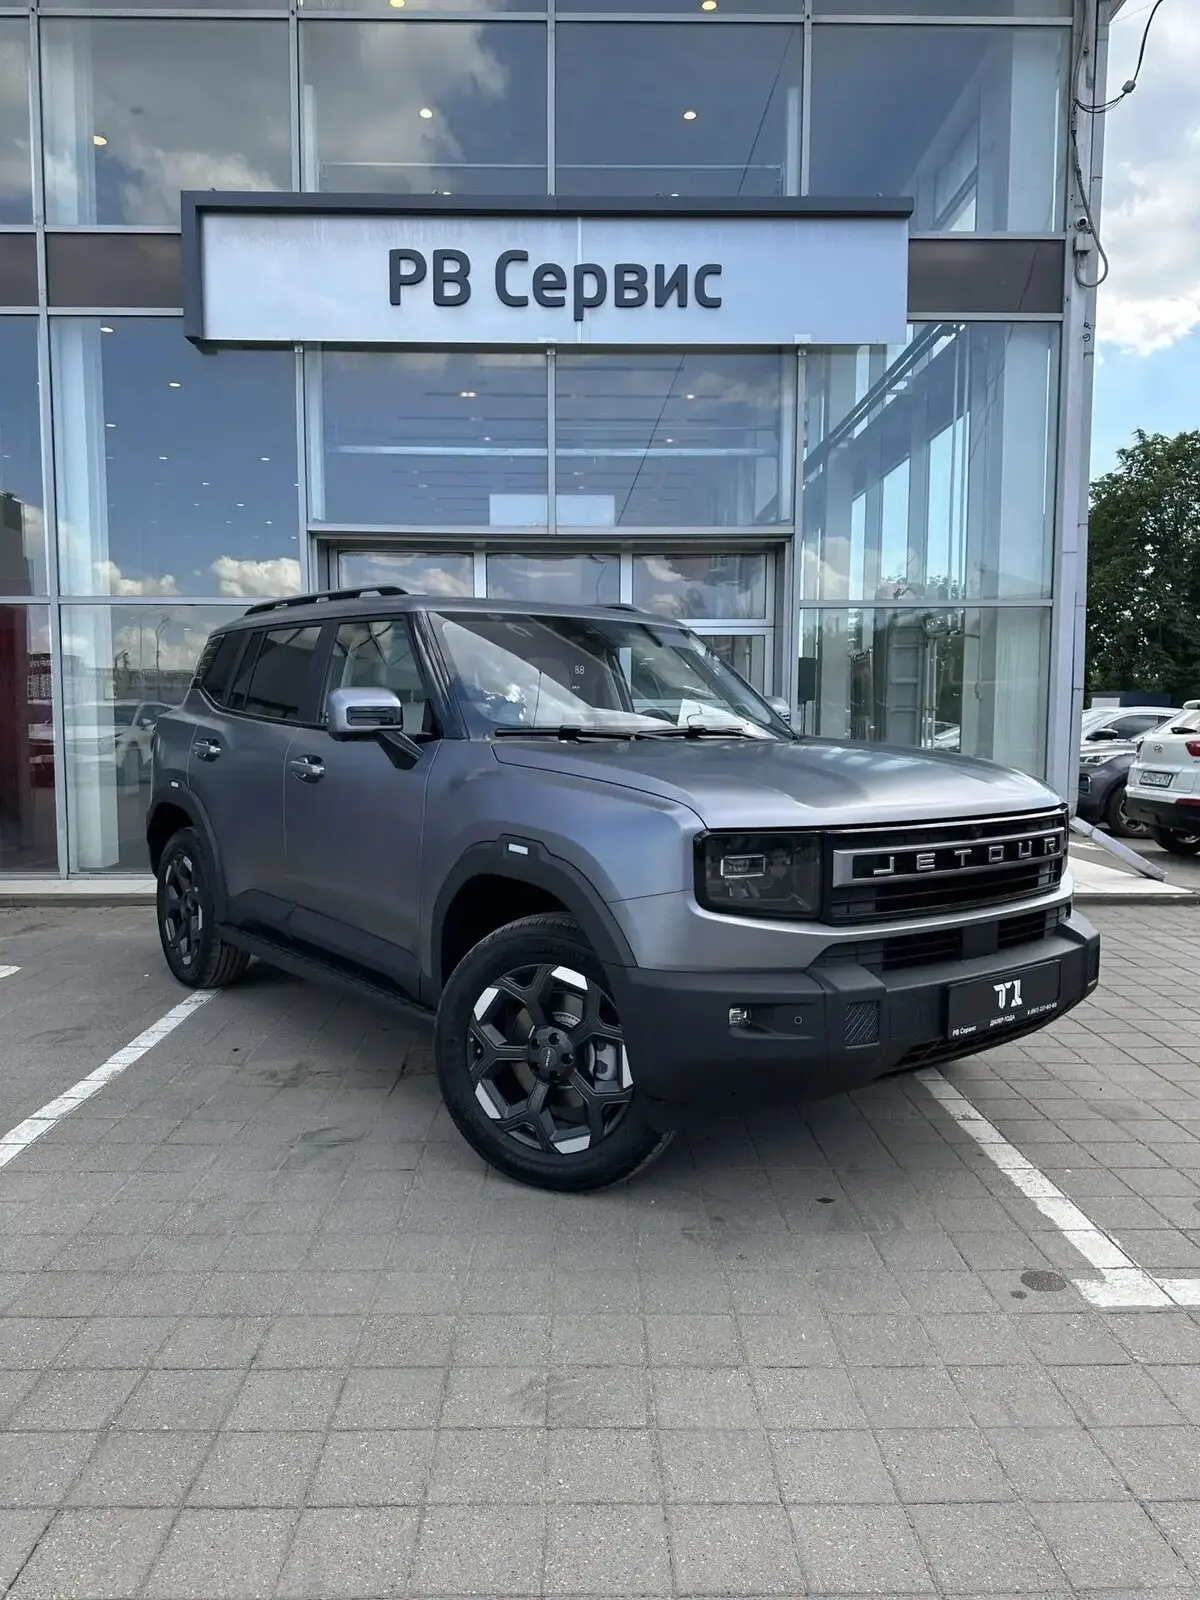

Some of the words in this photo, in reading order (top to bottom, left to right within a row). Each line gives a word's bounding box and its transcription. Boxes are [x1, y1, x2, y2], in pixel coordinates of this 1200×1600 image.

[389, 248, 471, 306] РВ
[494, 249, 722, 322] Сервис
[872, 837, 1057, 875] JETOUR
